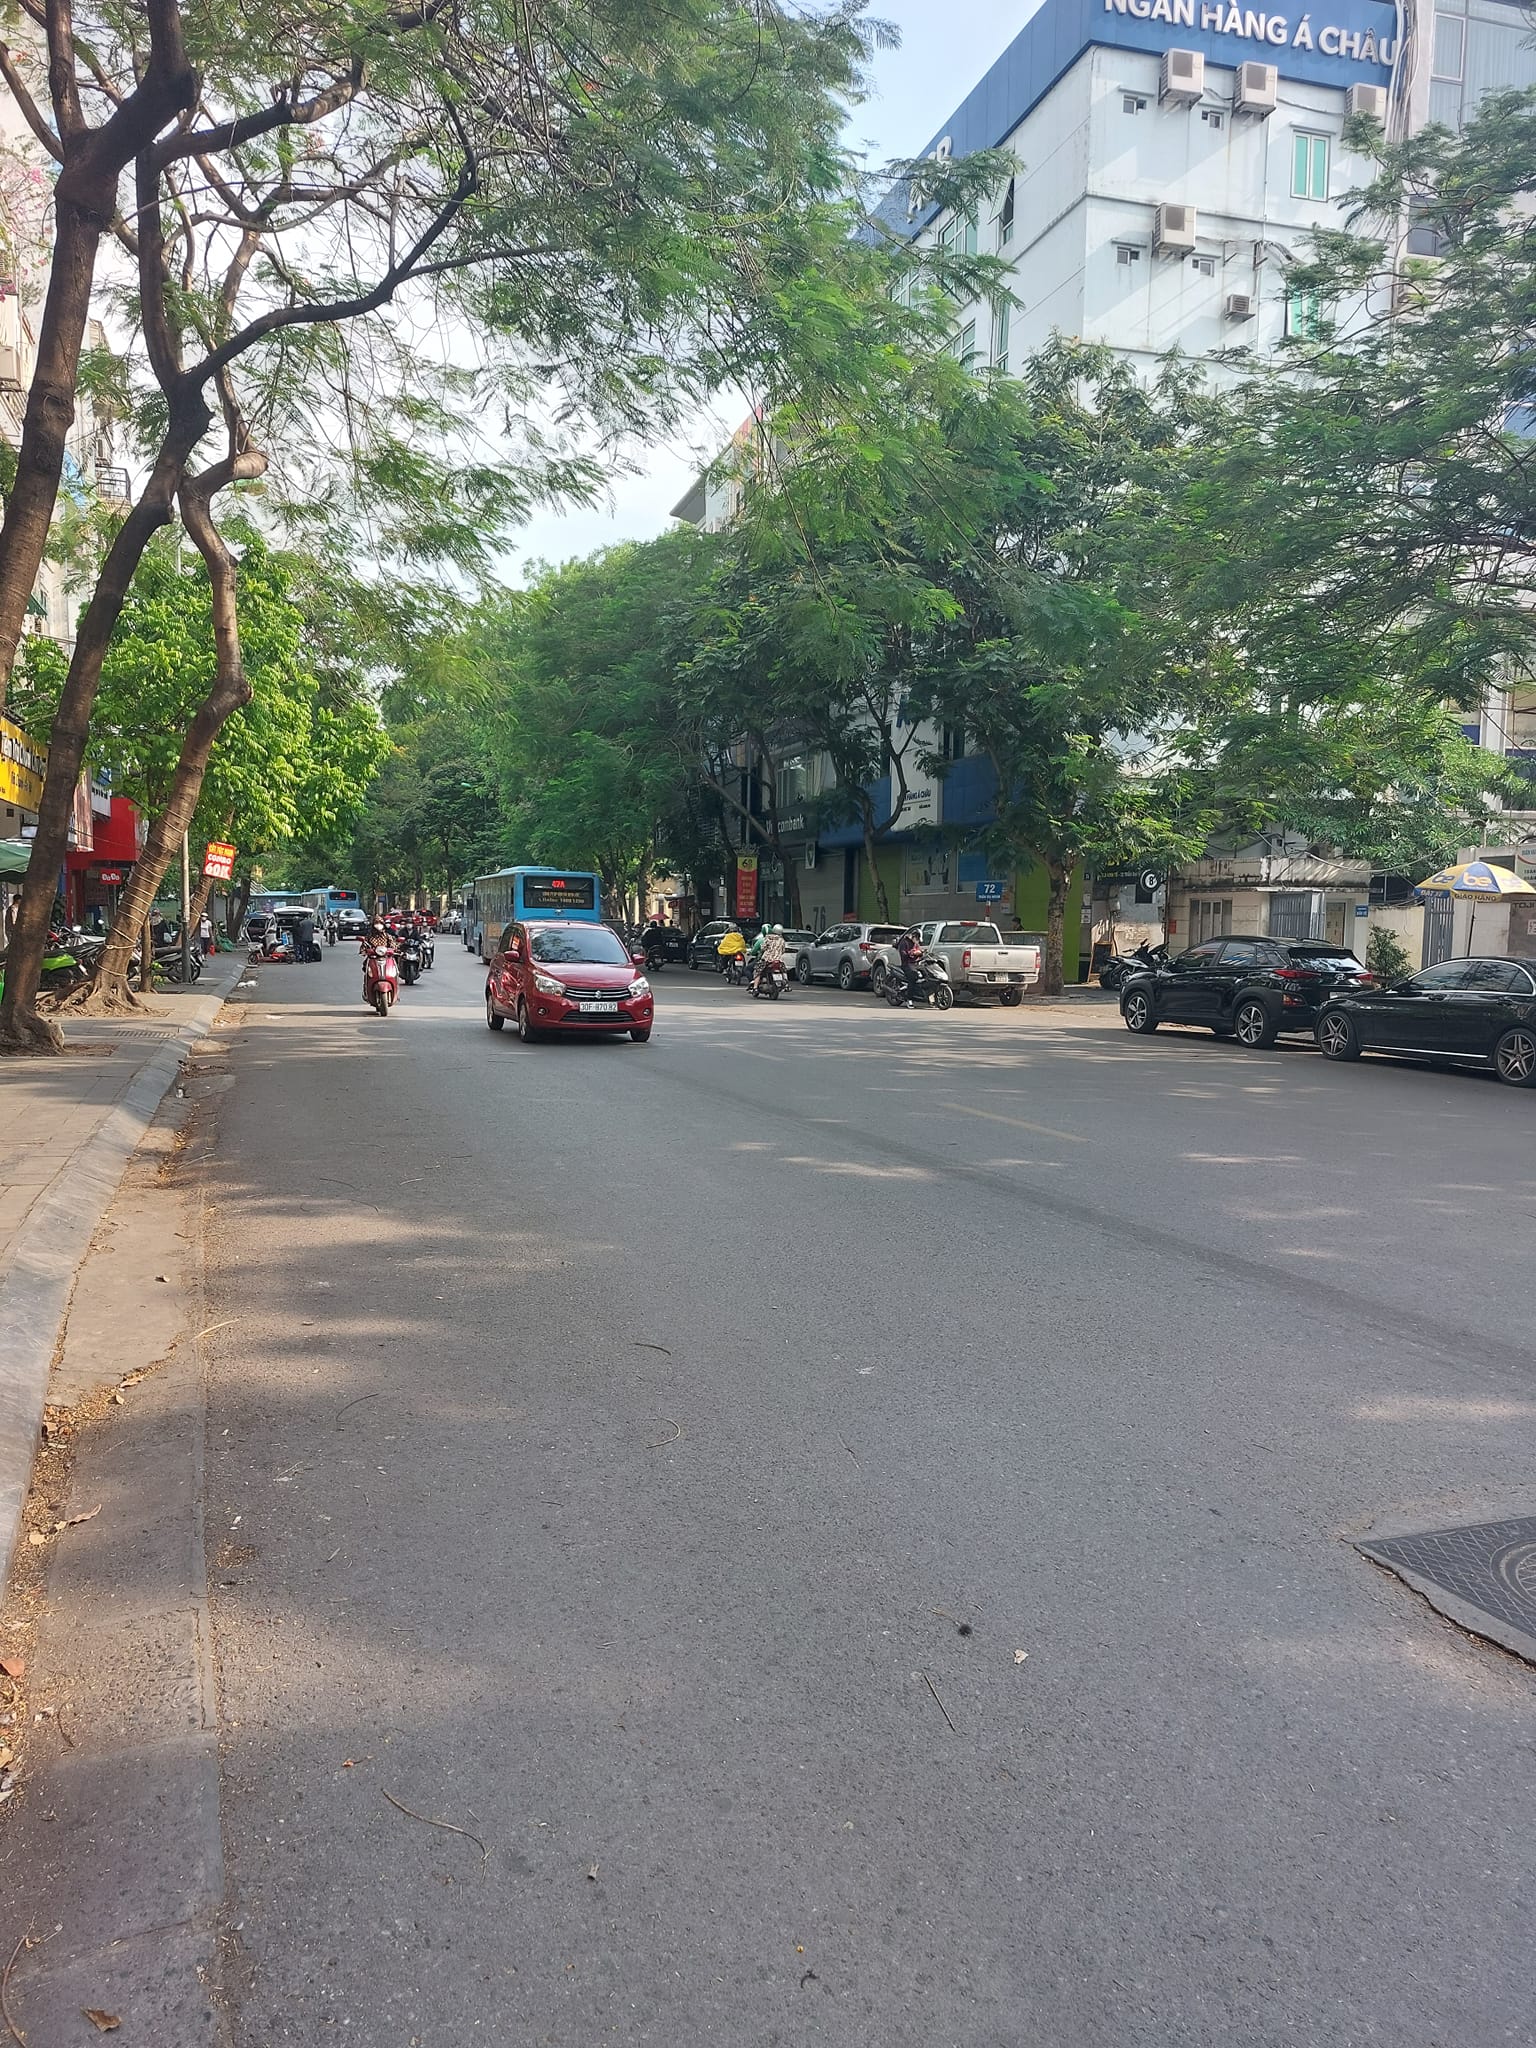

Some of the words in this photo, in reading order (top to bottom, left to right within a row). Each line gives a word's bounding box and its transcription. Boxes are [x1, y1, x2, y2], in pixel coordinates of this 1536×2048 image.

[1201, 1, 1288, 45] HÀNG
[1293, 14, 1313, 51] Á
[1462, 871, 1493, 888] be
[983, 883, 996, 894] 72
